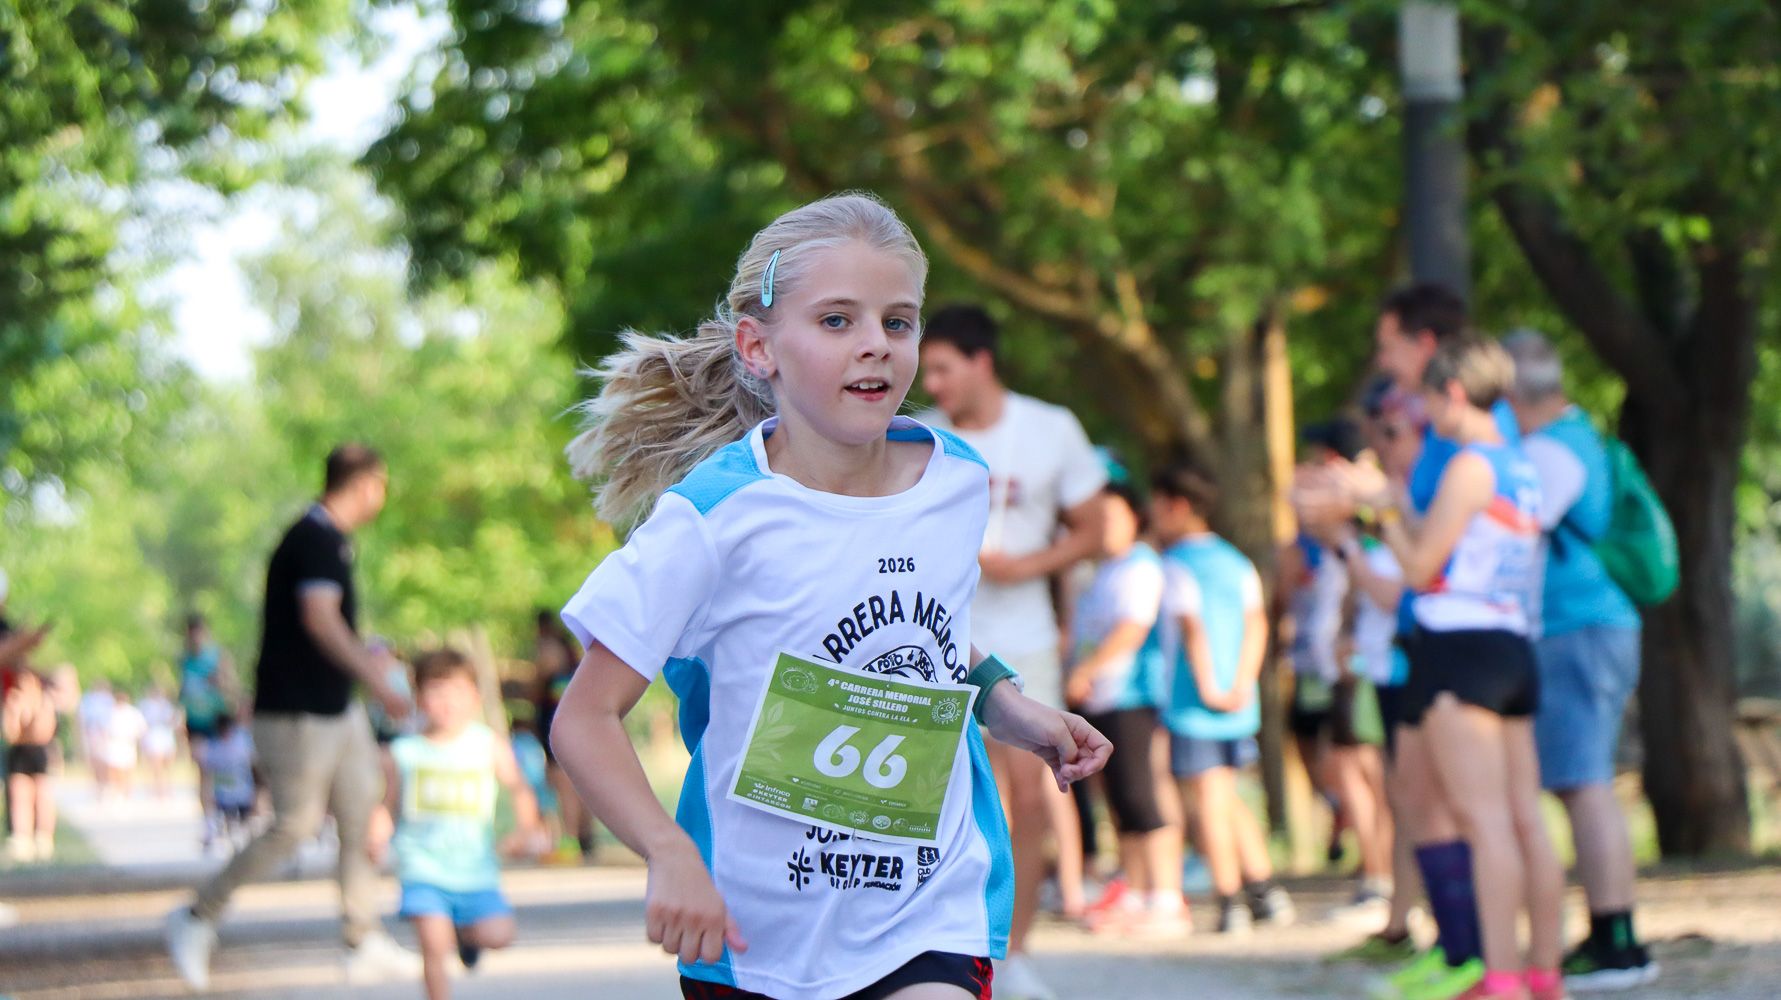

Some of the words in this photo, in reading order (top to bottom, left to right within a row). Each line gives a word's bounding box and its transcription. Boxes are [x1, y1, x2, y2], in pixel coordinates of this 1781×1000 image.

[878, 557, 915, 574] 2026
[812, 590, 905, 664] RRERA
[840, 682, 884, 698] CARRERA
[884, 690, 932, 706] MEMORIAL
[848, 694, 873, 707] JOSÉ
[872, 699, 909, 713] SILLERO
[842, 704, 866, 715] JUNTOS
[866, 709, 890, 719] CONTRA
[813, 724, 908, 789] 66
[820, 852, 904, 880] KEYTER
